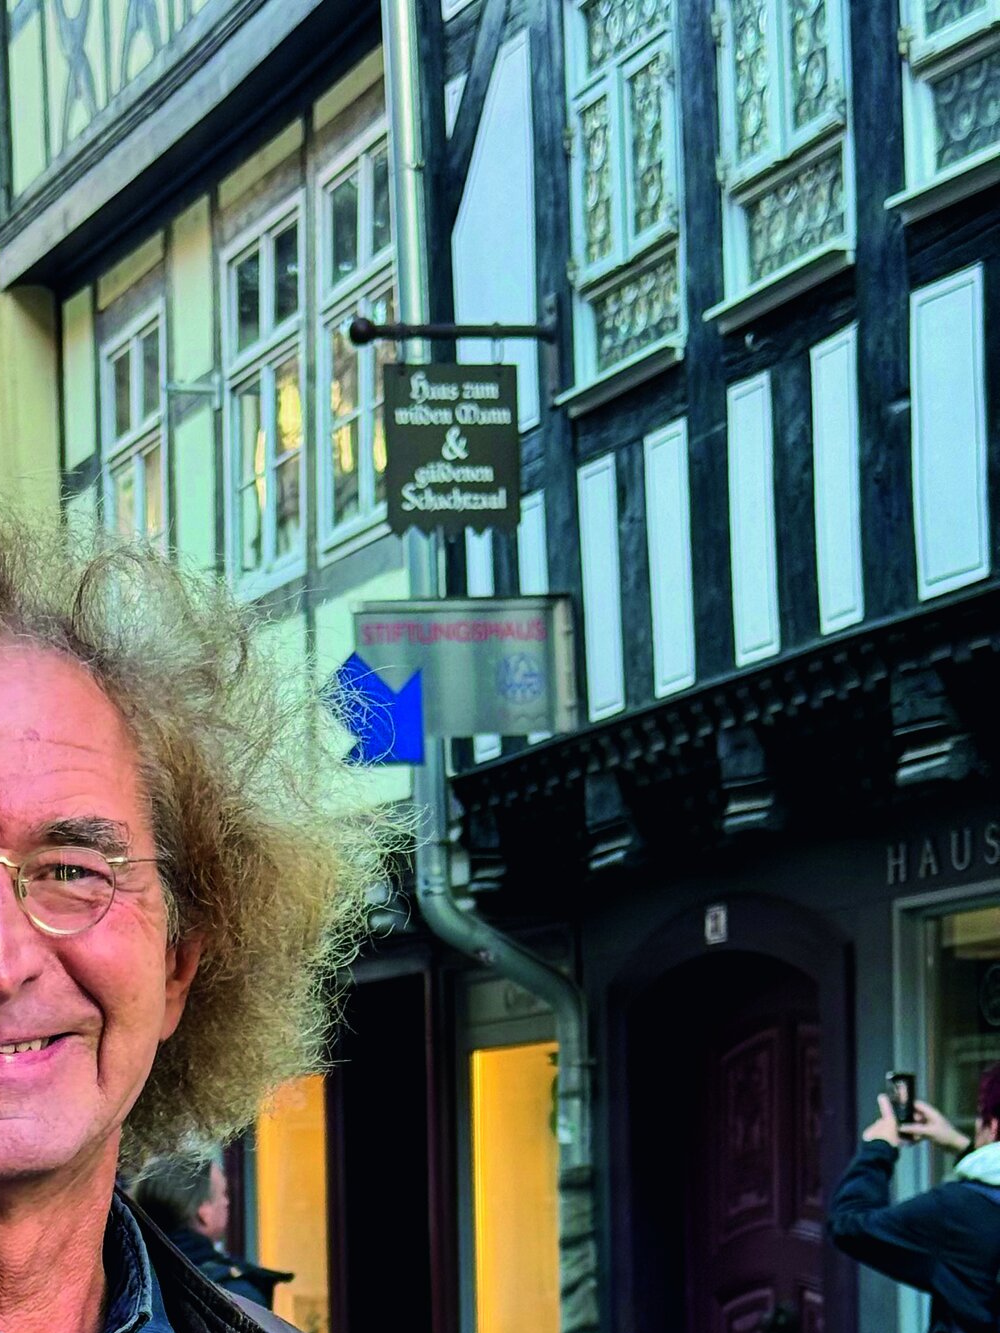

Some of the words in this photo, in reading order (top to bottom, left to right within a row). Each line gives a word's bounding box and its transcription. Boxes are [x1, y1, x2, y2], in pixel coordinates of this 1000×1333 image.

[409, 370, 459, 403] Haus
[462, 381, 499, 400] zum
[454, 401, 511, 425] Mann
[441, 425, 469, 460] &
[414, 461, 494, 489] güldenen
[361, 618, 547, 646] STIFTUNGSHAUS
[886, 822, 1000, 885] HAUS
